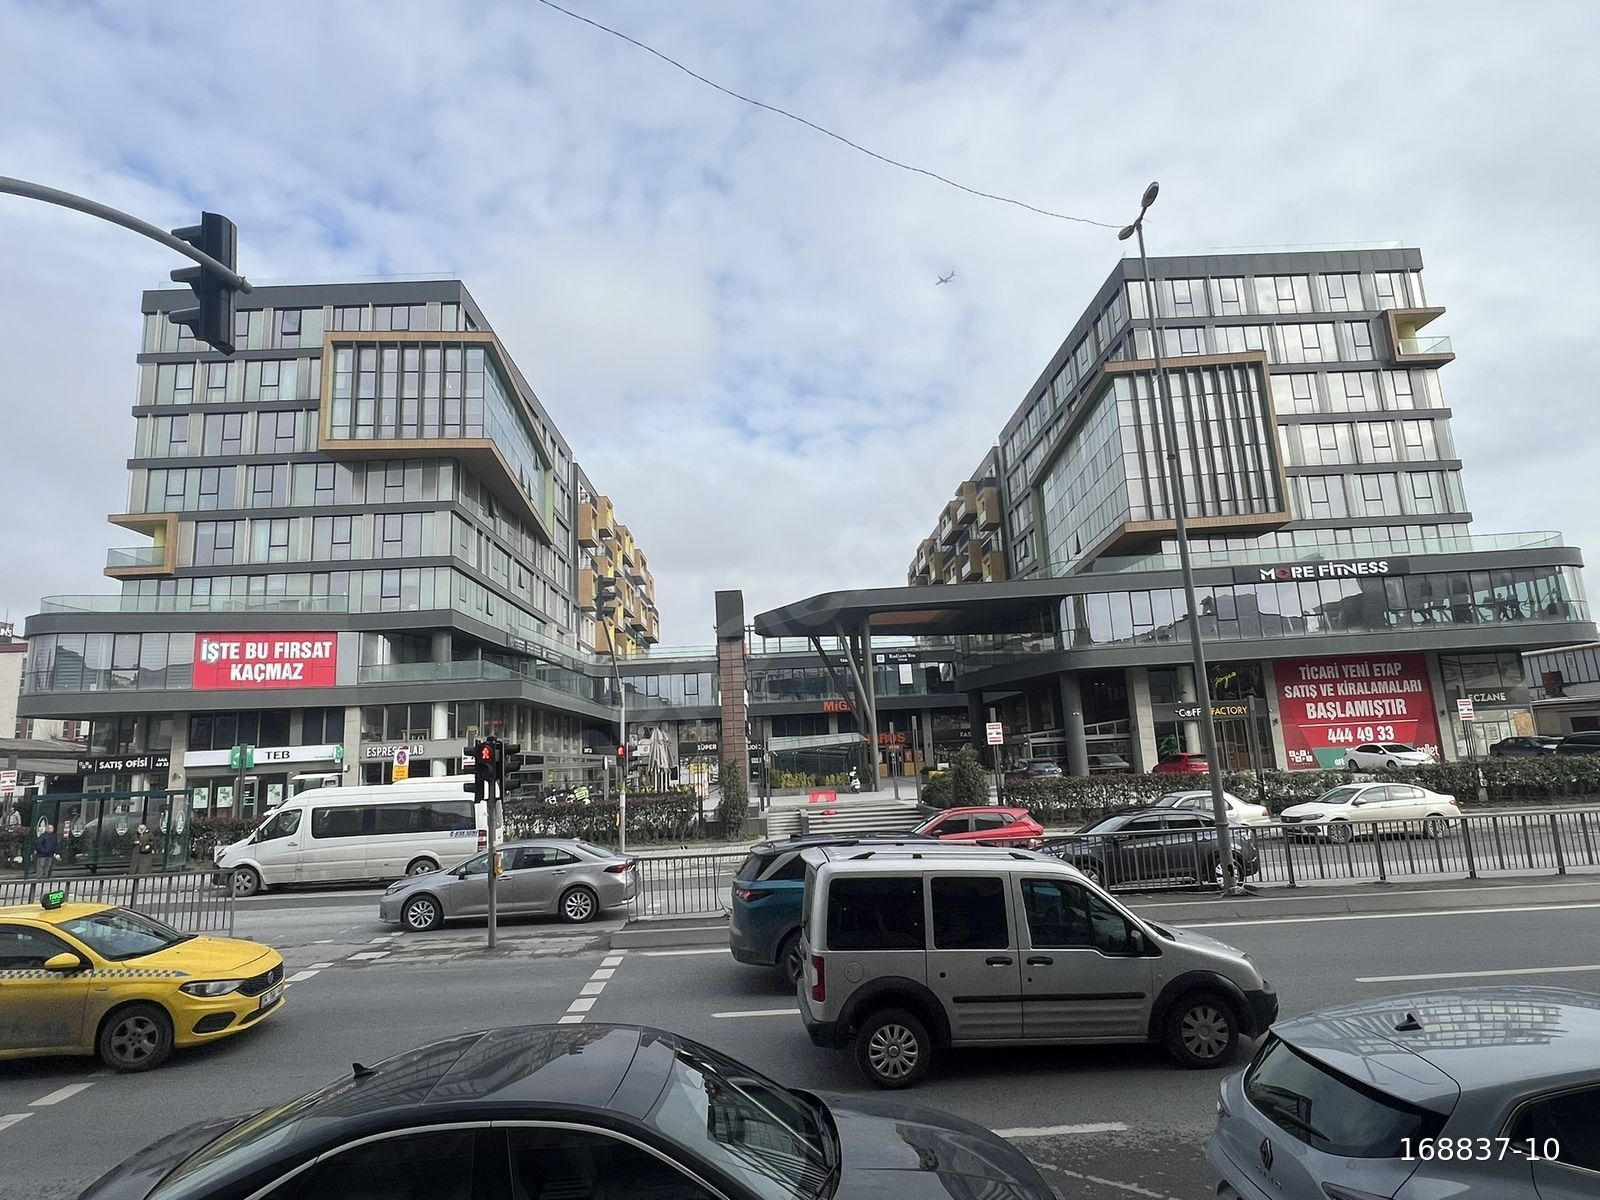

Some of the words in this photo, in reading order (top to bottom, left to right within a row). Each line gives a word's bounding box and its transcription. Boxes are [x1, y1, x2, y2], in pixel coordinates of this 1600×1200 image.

[1259, 565, 1315, 581] MORE
[201, 639, 240, 663] İŞTE
[245, 641, 269, 660] BU
[274, 641, 333, 660] FIRSAT
[230, 663, 304, 683] KAÇMAZ
[1299, 662, 1339, 680] TİCARİ
[1341, 661, 1370, 679] YENİ
[1373, 662, 1403, 677] ETAP
[1284, 684, 1317, 699] SATIŞ
[1319, 683, 1334, 697] VE
[1337, 679, 1422, 696] KİRALAMALARI
[1468, 692, 1507, 702] ECZANE
[1210, 706, 1248, 716] FACTORY
[1305, 698, 1407, 720] BAŞLAMIŞTIR
[1327, 727, 1354, 743] 444
[1356, 726, 1374, 742] 49
[1377, 725, 1395, 741] 33
[99, 760, 123, 771] SATIŞ
[125, 757, 148, 768] OFİSİ
[265, 750, 291, 760] TEB
